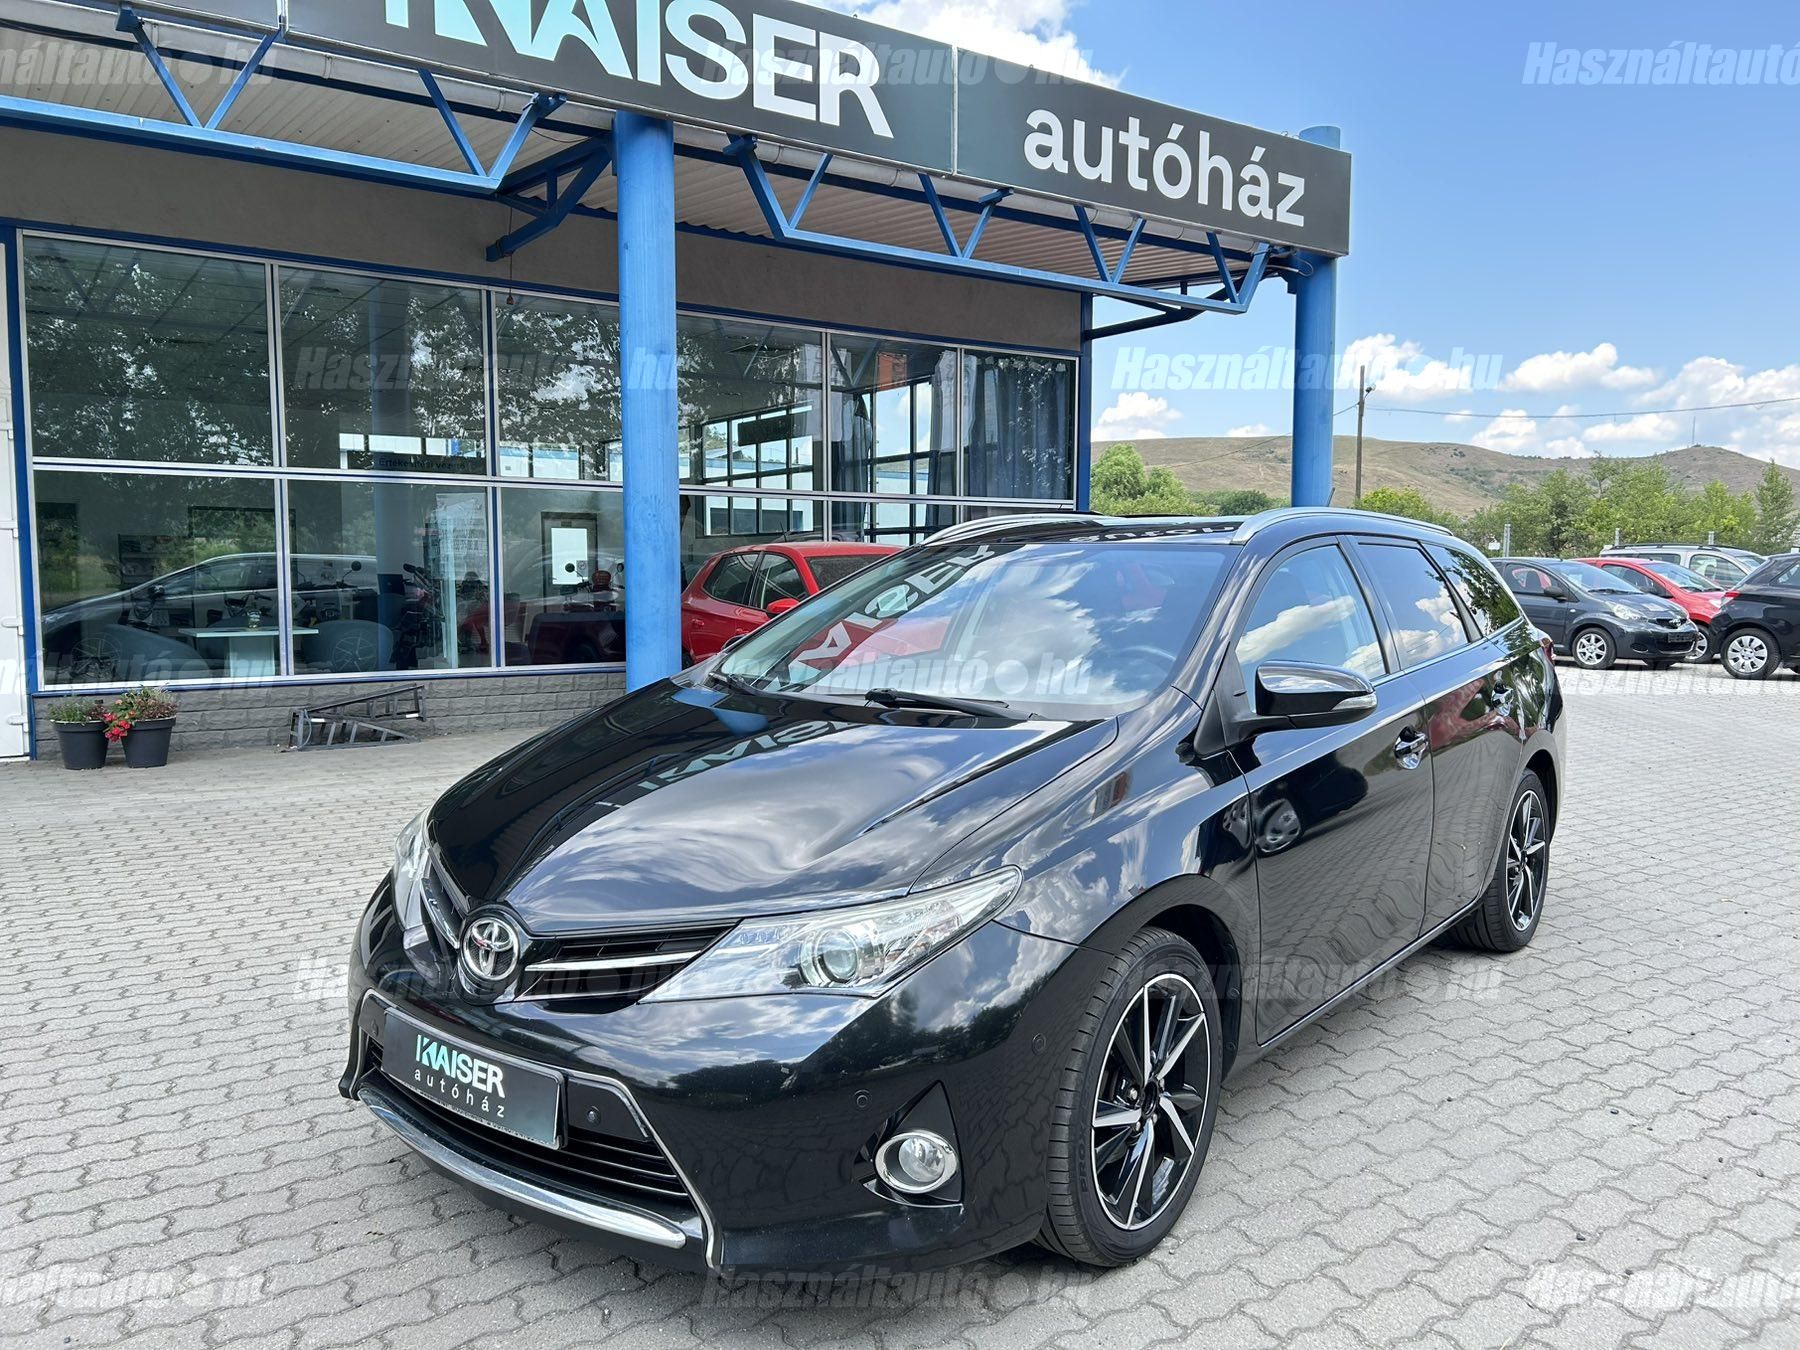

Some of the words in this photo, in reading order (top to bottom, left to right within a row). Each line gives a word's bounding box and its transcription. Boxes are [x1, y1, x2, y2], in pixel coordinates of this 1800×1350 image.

[385, 0, 894, 138] AISER
[1023, 108, 1305, 227] autóház
[414, 1068, 505, 1118] autóház
[415, 1034, 506, 1099] KAISER
